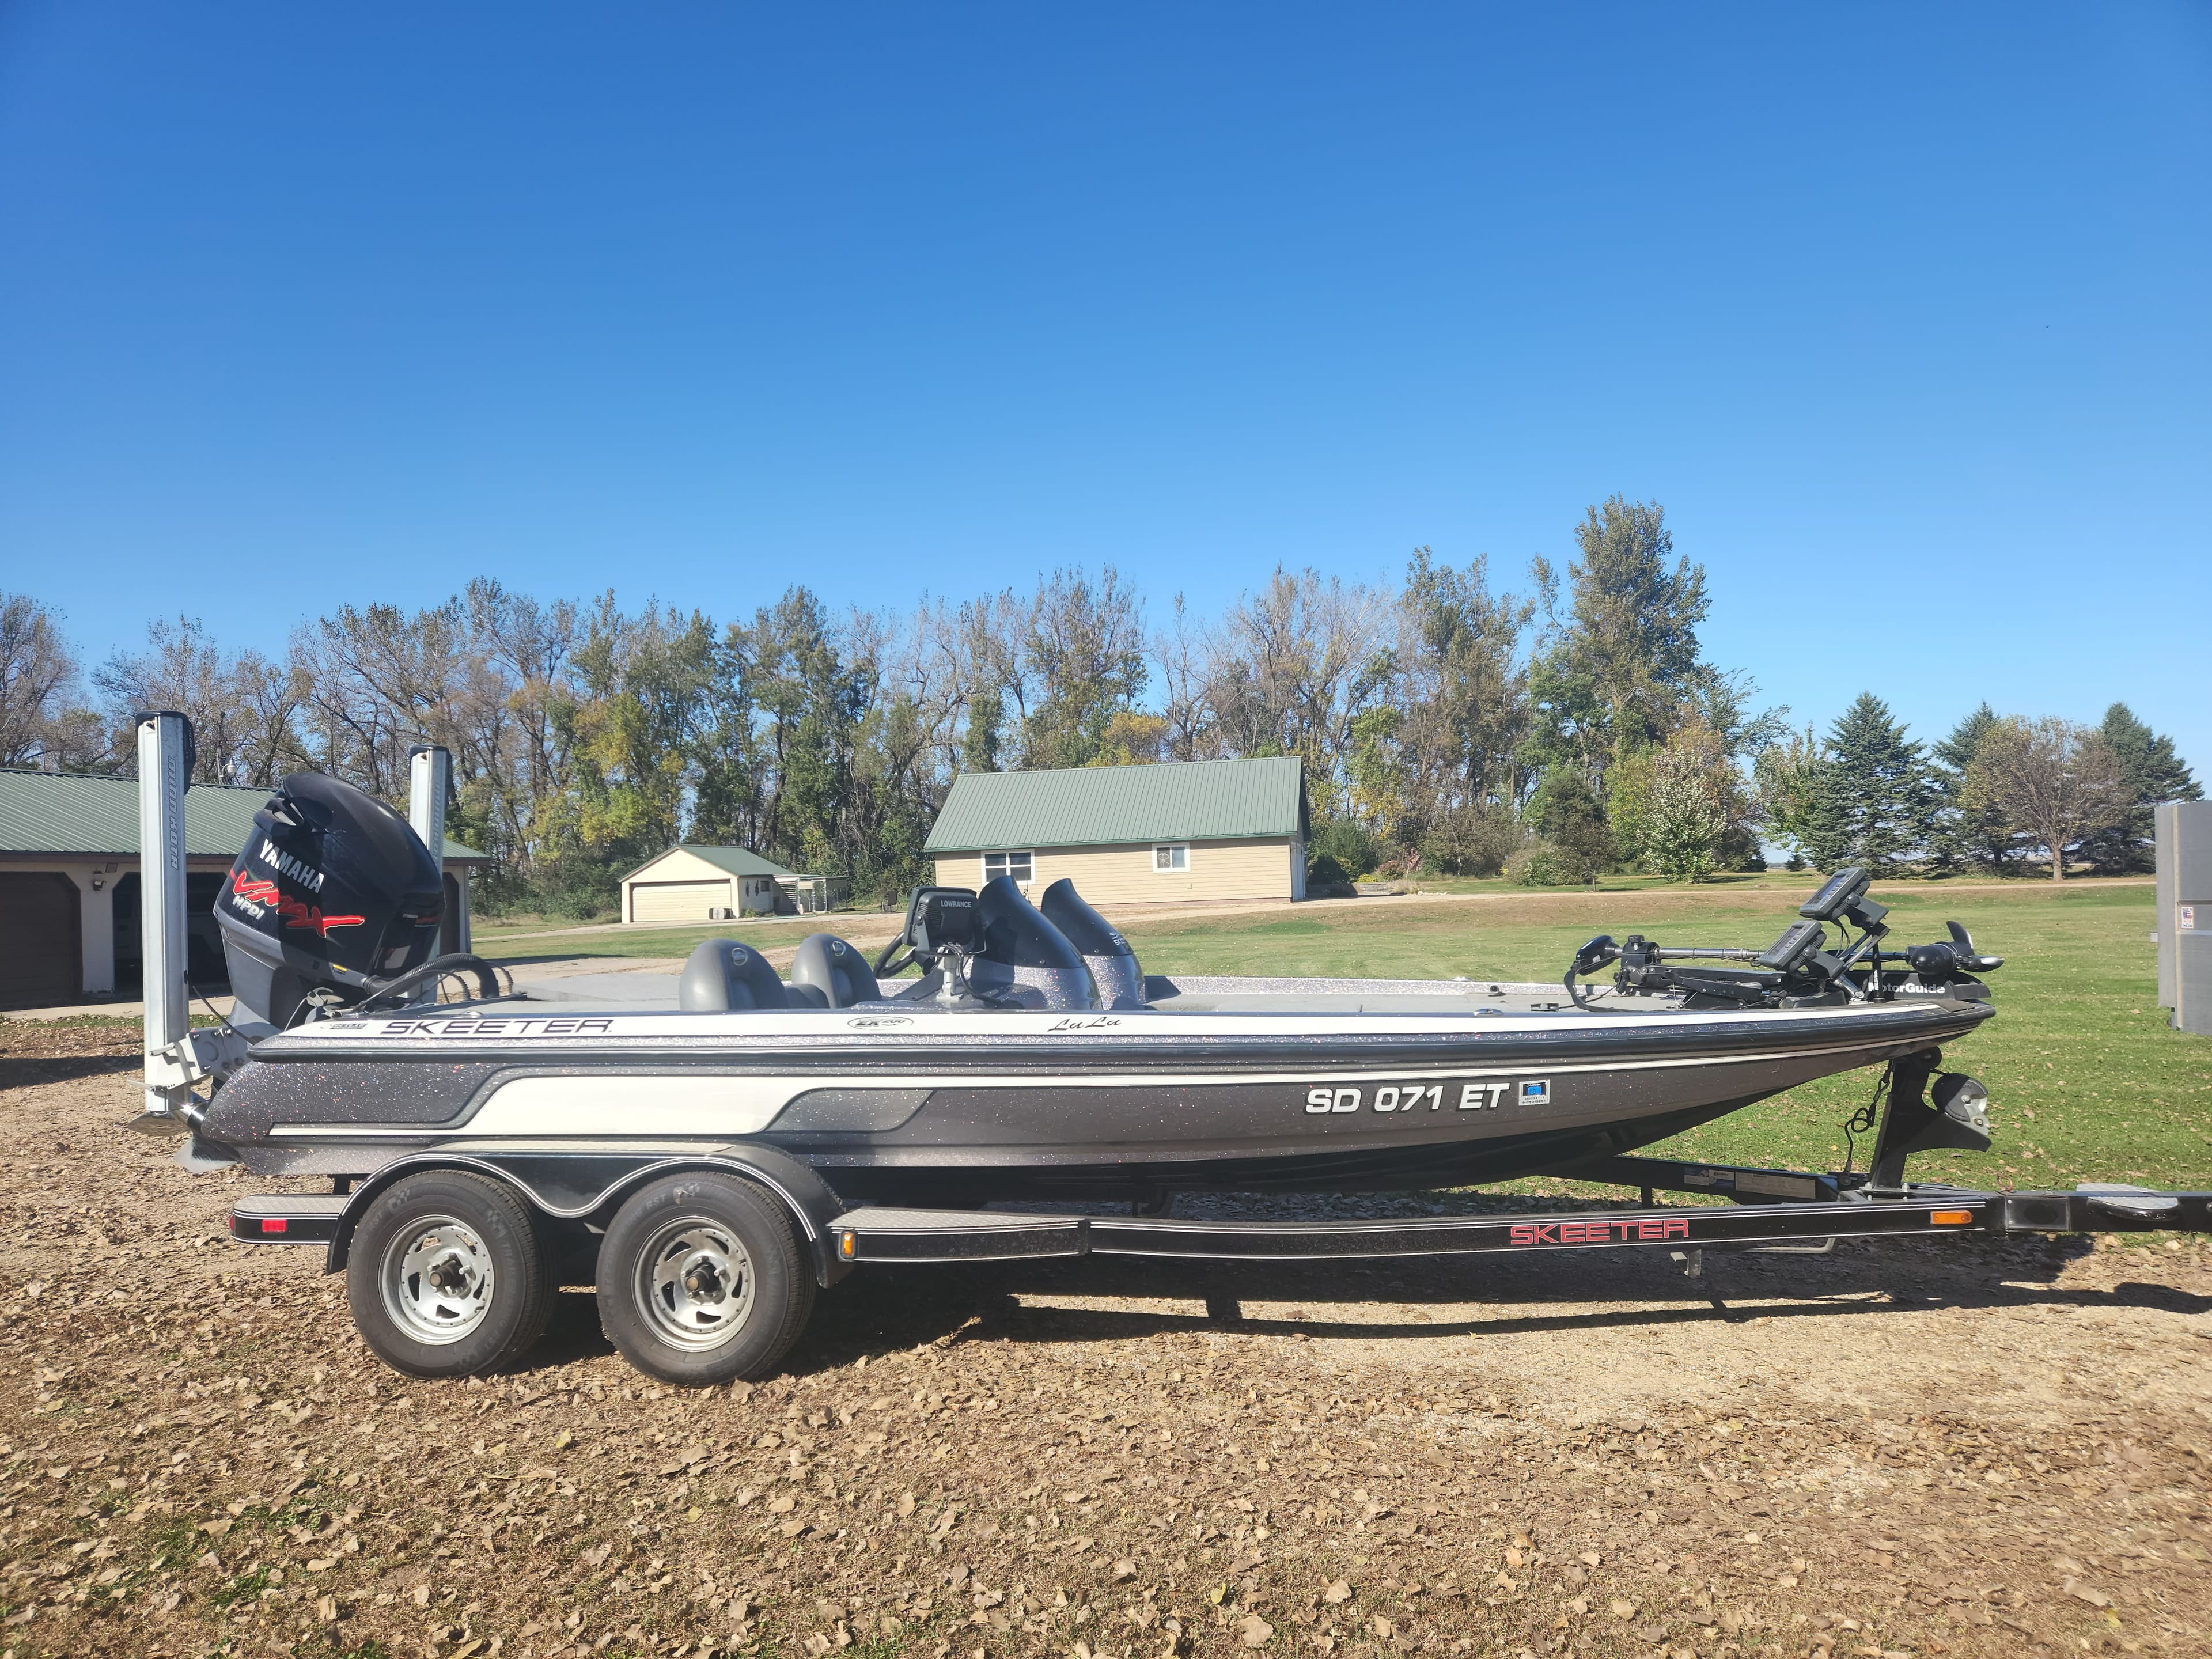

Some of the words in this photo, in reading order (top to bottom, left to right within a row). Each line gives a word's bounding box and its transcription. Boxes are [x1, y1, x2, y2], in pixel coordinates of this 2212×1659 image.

[169, 816, 179, 871] KOTA
[259, 838, 325, 893] YAMAHA
[232, 895, 266, 920] HPDI
[941, 900, 972, 908] LOWRANCE
[380, 1019, 614, 1035] SKEETER
[1305, 1088, 1362, 1114] SD
[1374, 1085, 1444, 1112] 071
[1459, 1082, 1510, 1110] ET
[643, 1192, 667, 1210] RST
[1510, 1219, 1690, 1245] SKEETER
